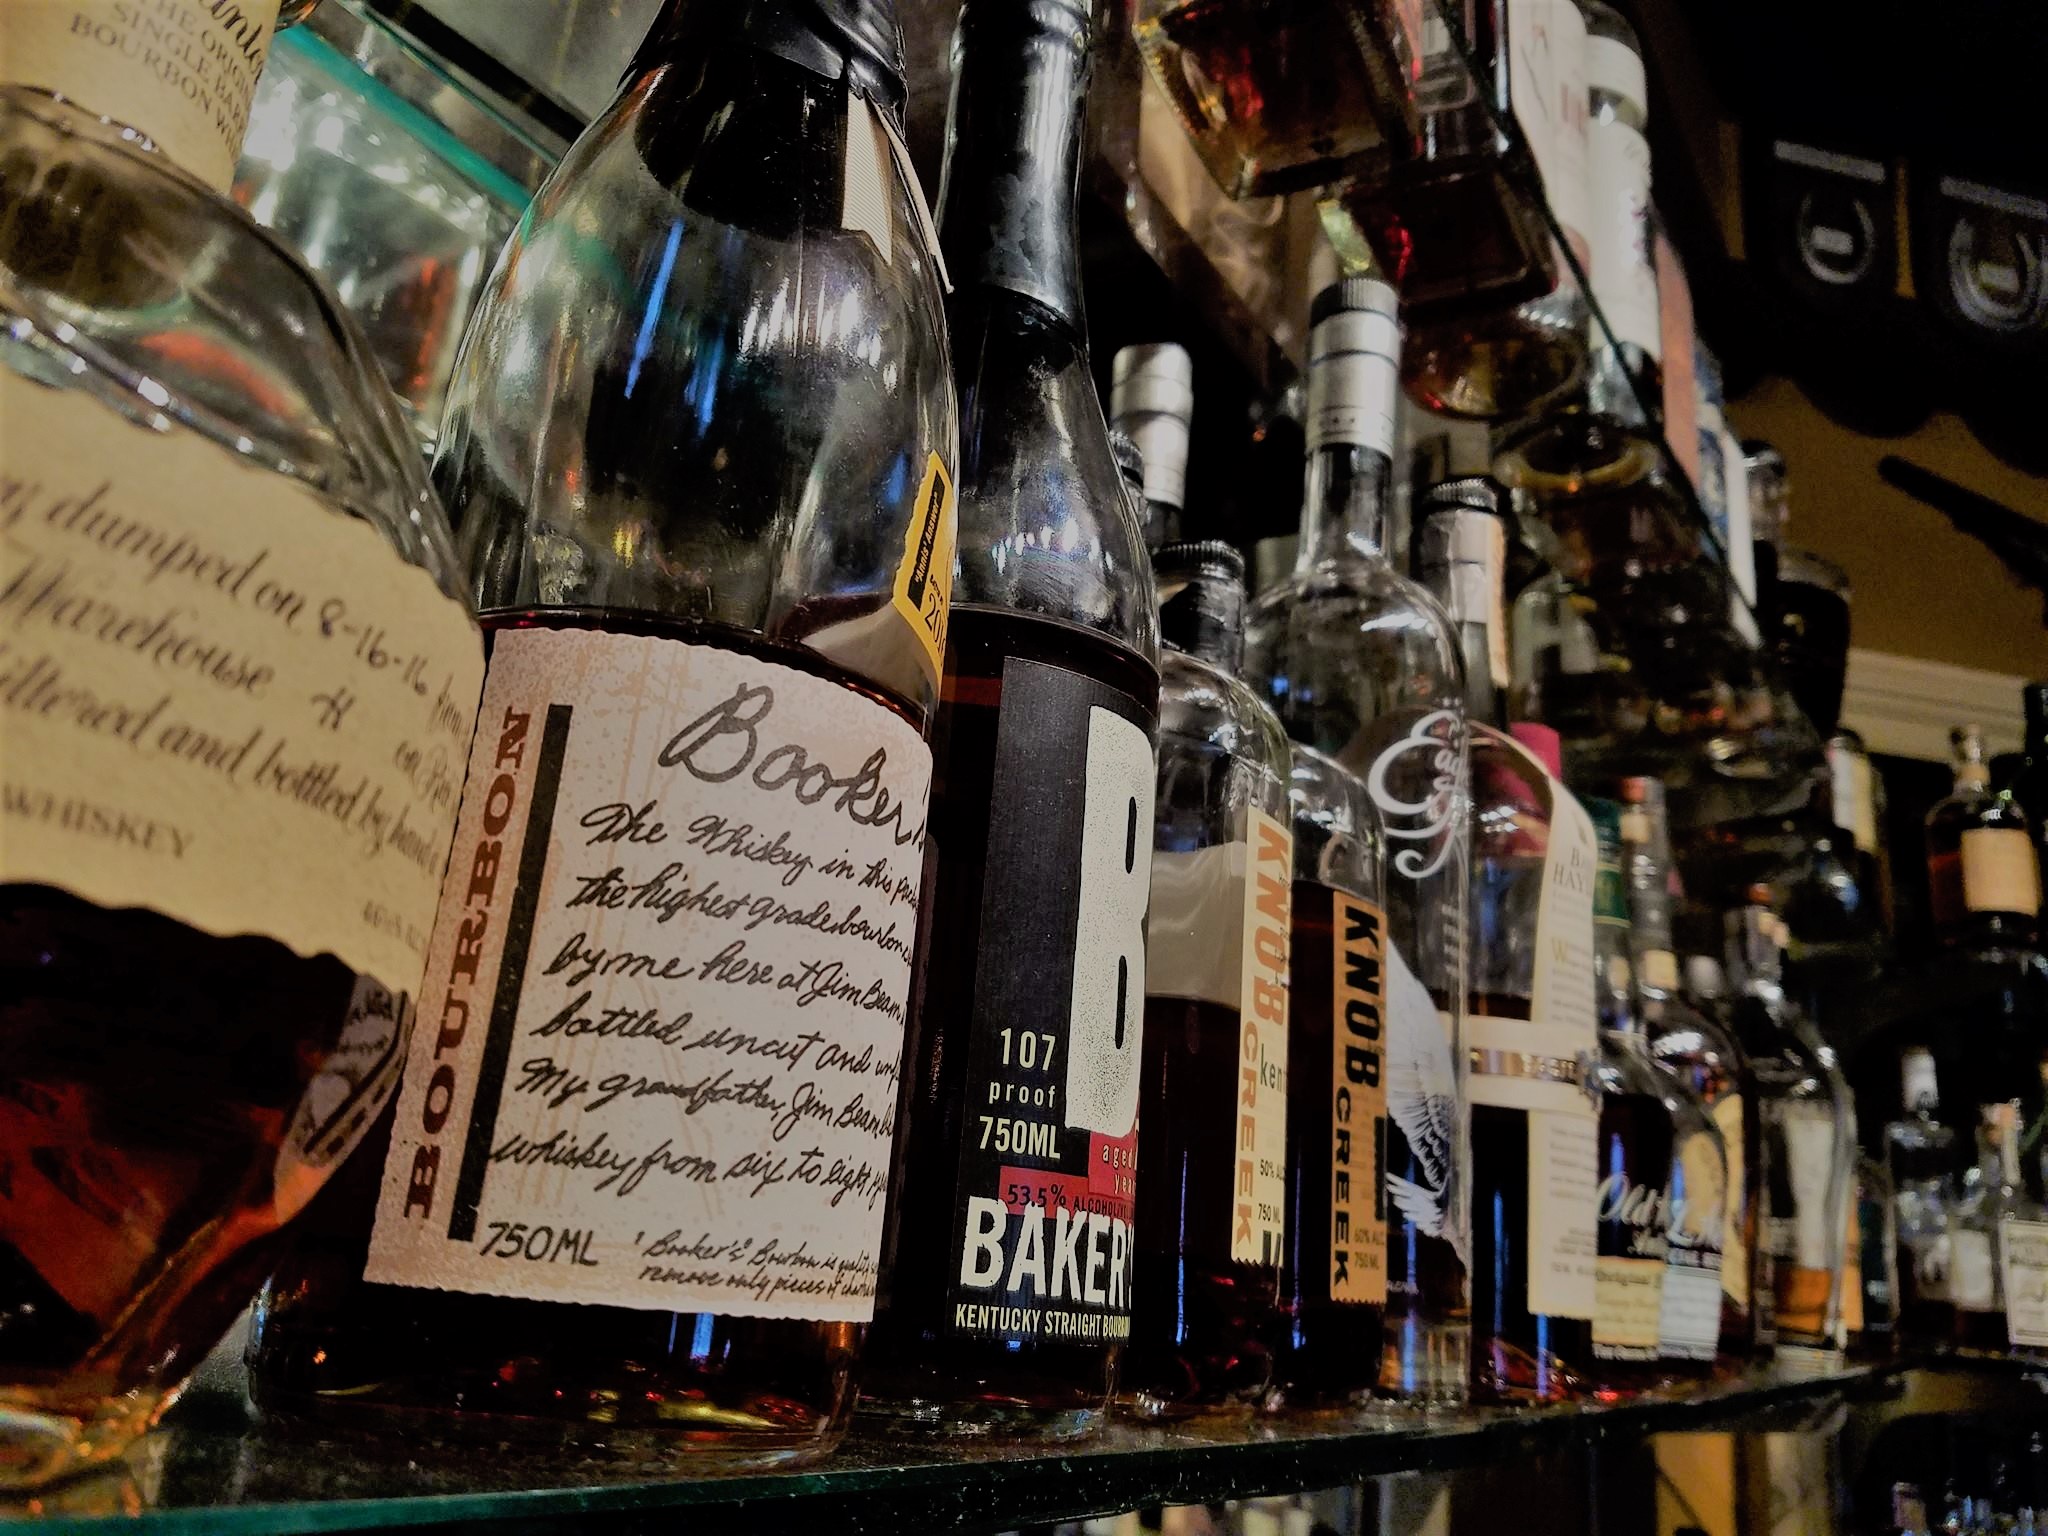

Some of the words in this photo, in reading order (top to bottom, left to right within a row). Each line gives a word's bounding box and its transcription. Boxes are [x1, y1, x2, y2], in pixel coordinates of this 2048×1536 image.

[70, 14, 210, 114] BOURBON
[114, 2, 211, 84] SINGLE
[46, 480, 270, 600] dumped
[580, 800, 668, 847] The
[819, 849, 854, 879] in
[858, 858, 893, 894] this
[566, 866, 628, 909] the
[1065, 704, 1155, 1138] B
[1253, 822, 1290, 1026] KNOB
[404, 705, 531, 1218] BOURBON
[543, 932, 603, 985] by
[700, 940, 773, 984] here
[777, 960, 820, 992] at
[797, 961, 861, 1007] Jim
[1344, 905, 1380, 1089] KNOB
[530, 990, 691, 1047] bottled
[682, 1030, 825, 1072] uncut
[1000, 1027, 1056, 1071] 107
[773, 1082, 833, 1142] Jim
[989, 1080, 1056, 1108] proof
[978, 1115, 1061, 1159] 750ML
[1235, 1022, 1259, 1246] CREEK
[487, 1131, 638, 1191] whiskey
[617, 1139, 717, 1197] from
[723, 1150, 787, 1197] six
[788, 1146, 824, 1184] to
[1259, 1159, 1275, 1179] 50%
[1333, 1086, 1351, 1286] CREEK
[1007, 1183, 1067, 1208] 53.5%
[1258, 1203, 1272, 1221] 750
[479, 1222, 599, 1267] 750ML
[725, 1266, 771, 1300] only
[956, 1303, 1040, 1332] KENTUCKY
[1045, 1310, 1101, 1337] STRAIGHT
